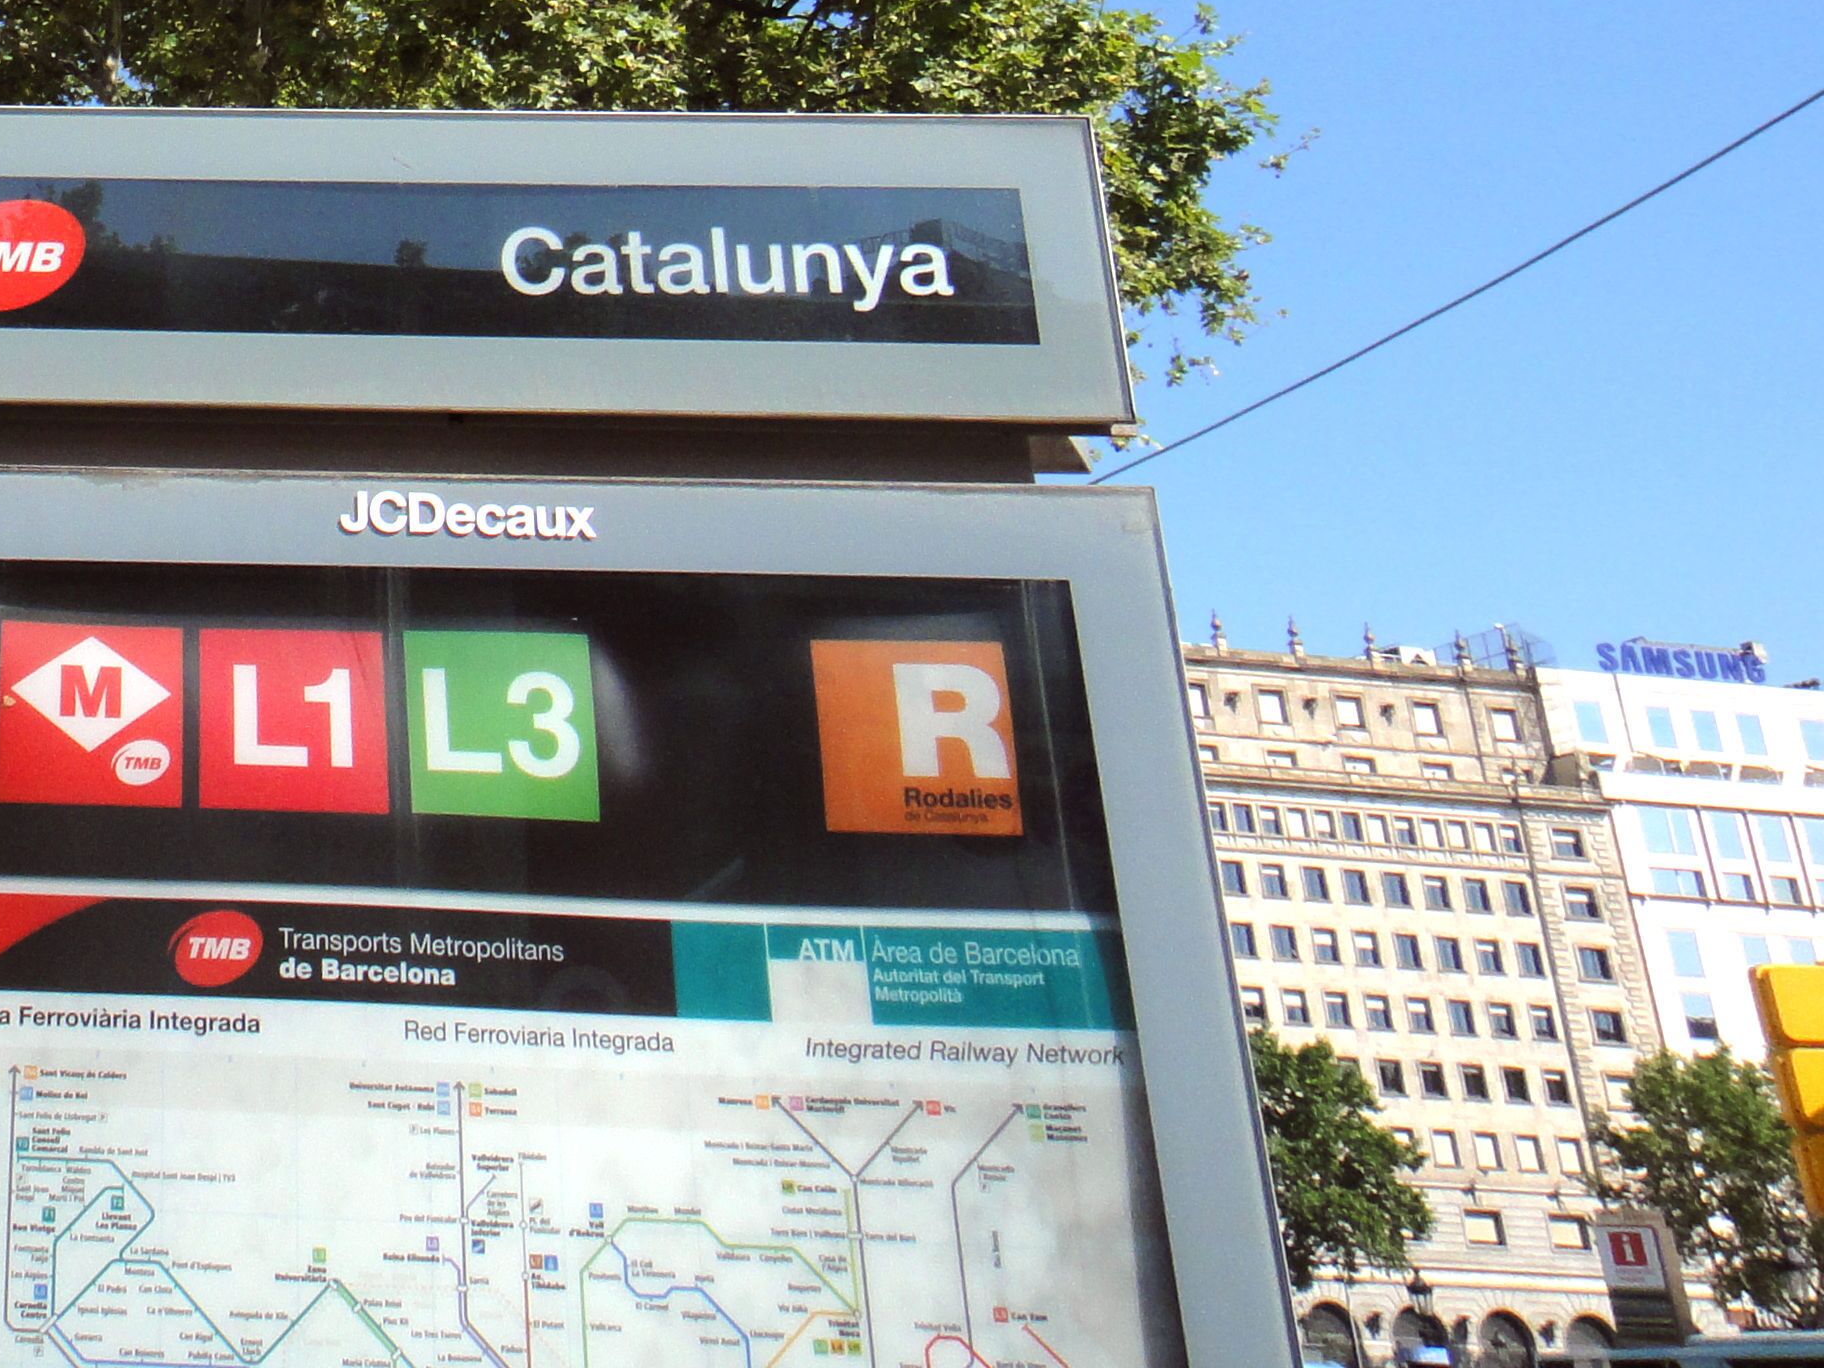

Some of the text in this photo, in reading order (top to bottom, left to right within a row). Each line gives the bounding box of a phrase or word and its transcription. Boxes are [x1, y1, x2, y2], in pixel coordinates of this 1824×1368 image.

[501, 225, 955, 312] Catalunya
[339, 490, 597, 542] JCDecaux
[1596, 642, 1765, 682] SAMSUNG
[59, 664, 122, 718] M
[232, 664, 353, 768] L1
[422, 668, 581, 778] L3
[892, 663, 1011, 778] R
[124, 756, 162, 770] TMB
[904, 787, 1012, 809] Rodalies
[188, 938, 251, 960] TMB
[279, 928, 564, 963] Transports Metropolitans
[799, 939, 854, 961] ATM
[872, 935, 1080, 967] Àrea de Barcelona
[279, 958, 455, 986] de Barcelona
[873, 968, 1045, 988] Autoritat del Transport
[875, 987, 962, 1003] Metropolità
[19, 1006, 141, 1029] Ferroviària
[150, 1011, 260, 1036] Integrada
[404, 1020, 675, 1055] Red Ferroviaria Integrada
[806, 1037, 1125, 1066] Integrated Railway Network
